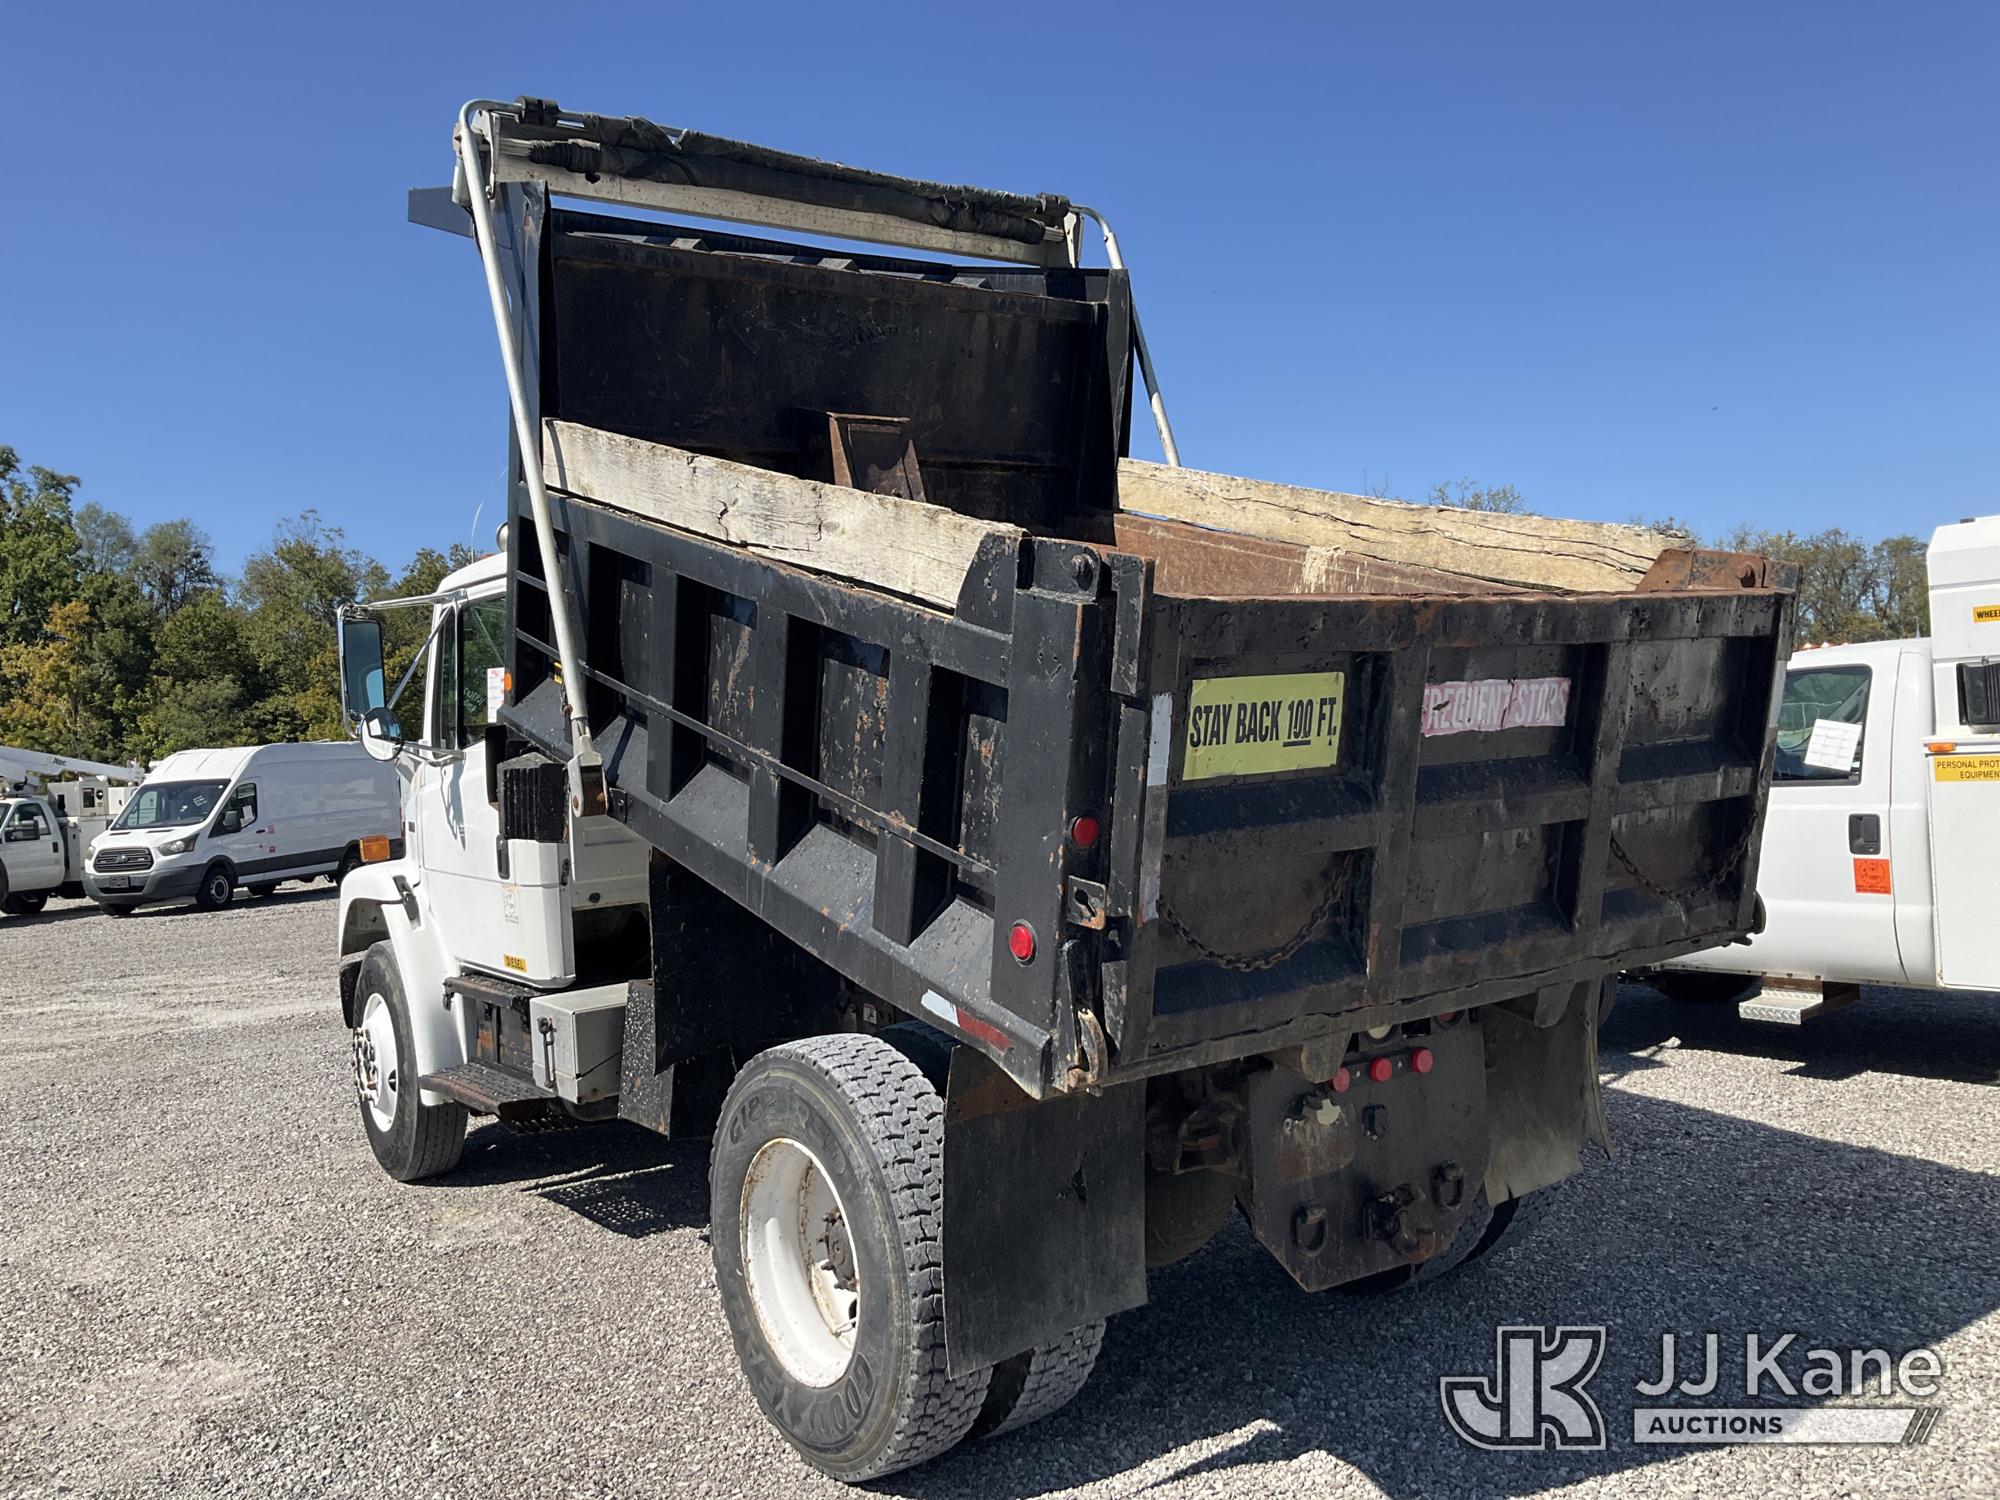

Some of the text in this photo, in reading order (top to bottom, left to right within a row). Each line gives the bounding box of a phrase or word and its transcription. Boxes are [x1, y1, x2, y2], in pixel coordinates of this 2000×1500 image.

[1977, 610, 2000, 618] WHEE
[1514, 681, 1569, 724] STOPS
[1190, 697, 1337, 748] STAY BACK 100 FT.
[1936, 760, 1977, 769] PERSONAL
[506, 956, 524, 970] DIESEL
